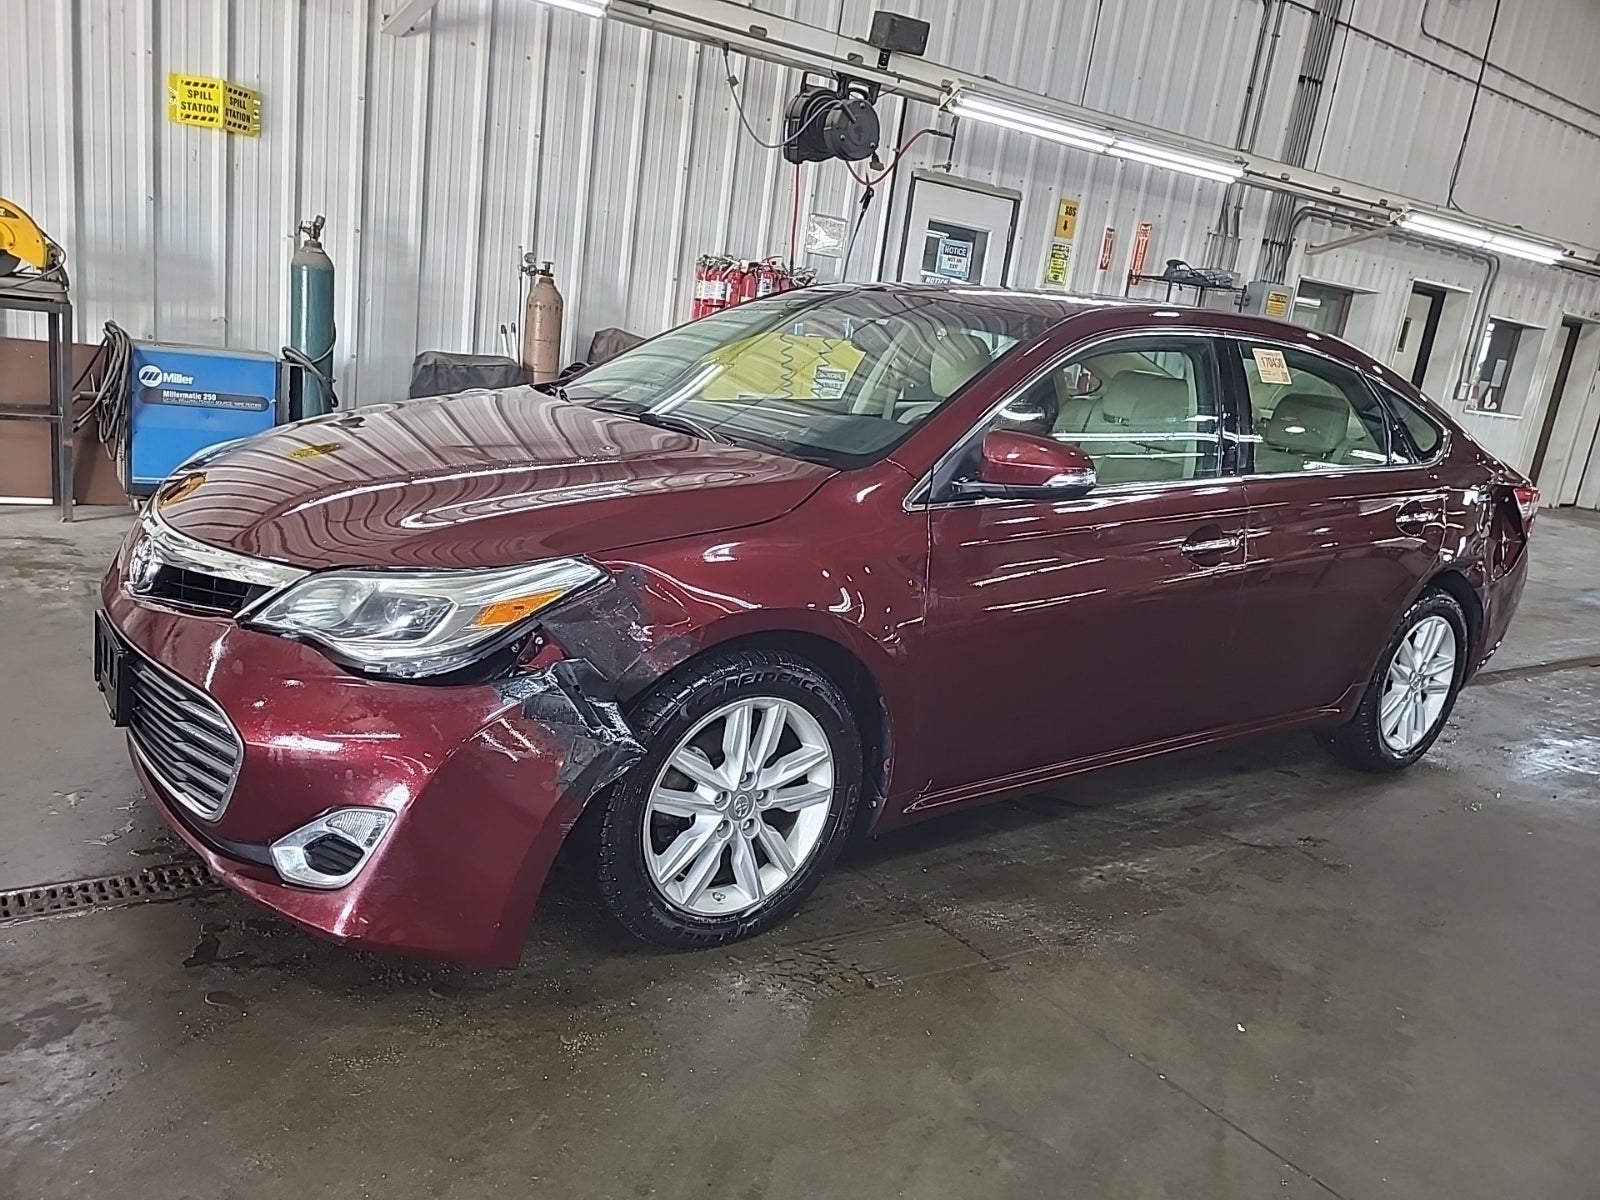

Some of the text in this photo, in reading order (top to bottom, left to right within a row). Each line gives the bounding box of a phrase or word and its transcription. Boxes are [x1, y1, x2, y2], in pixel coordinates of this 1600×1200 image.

[187, 89, 213, 101] SPILL
[180, 101, 219, 114] STATION
[229, 96, 247, 110] SPILL
[225, 107, 251, 123] STATION
[944, 244, 967, 257] NOTICE
[162, 372, 194, 385] Miller
[162, 390, 201, 400] Millermatic
[203, 393, 217, 401] 250
